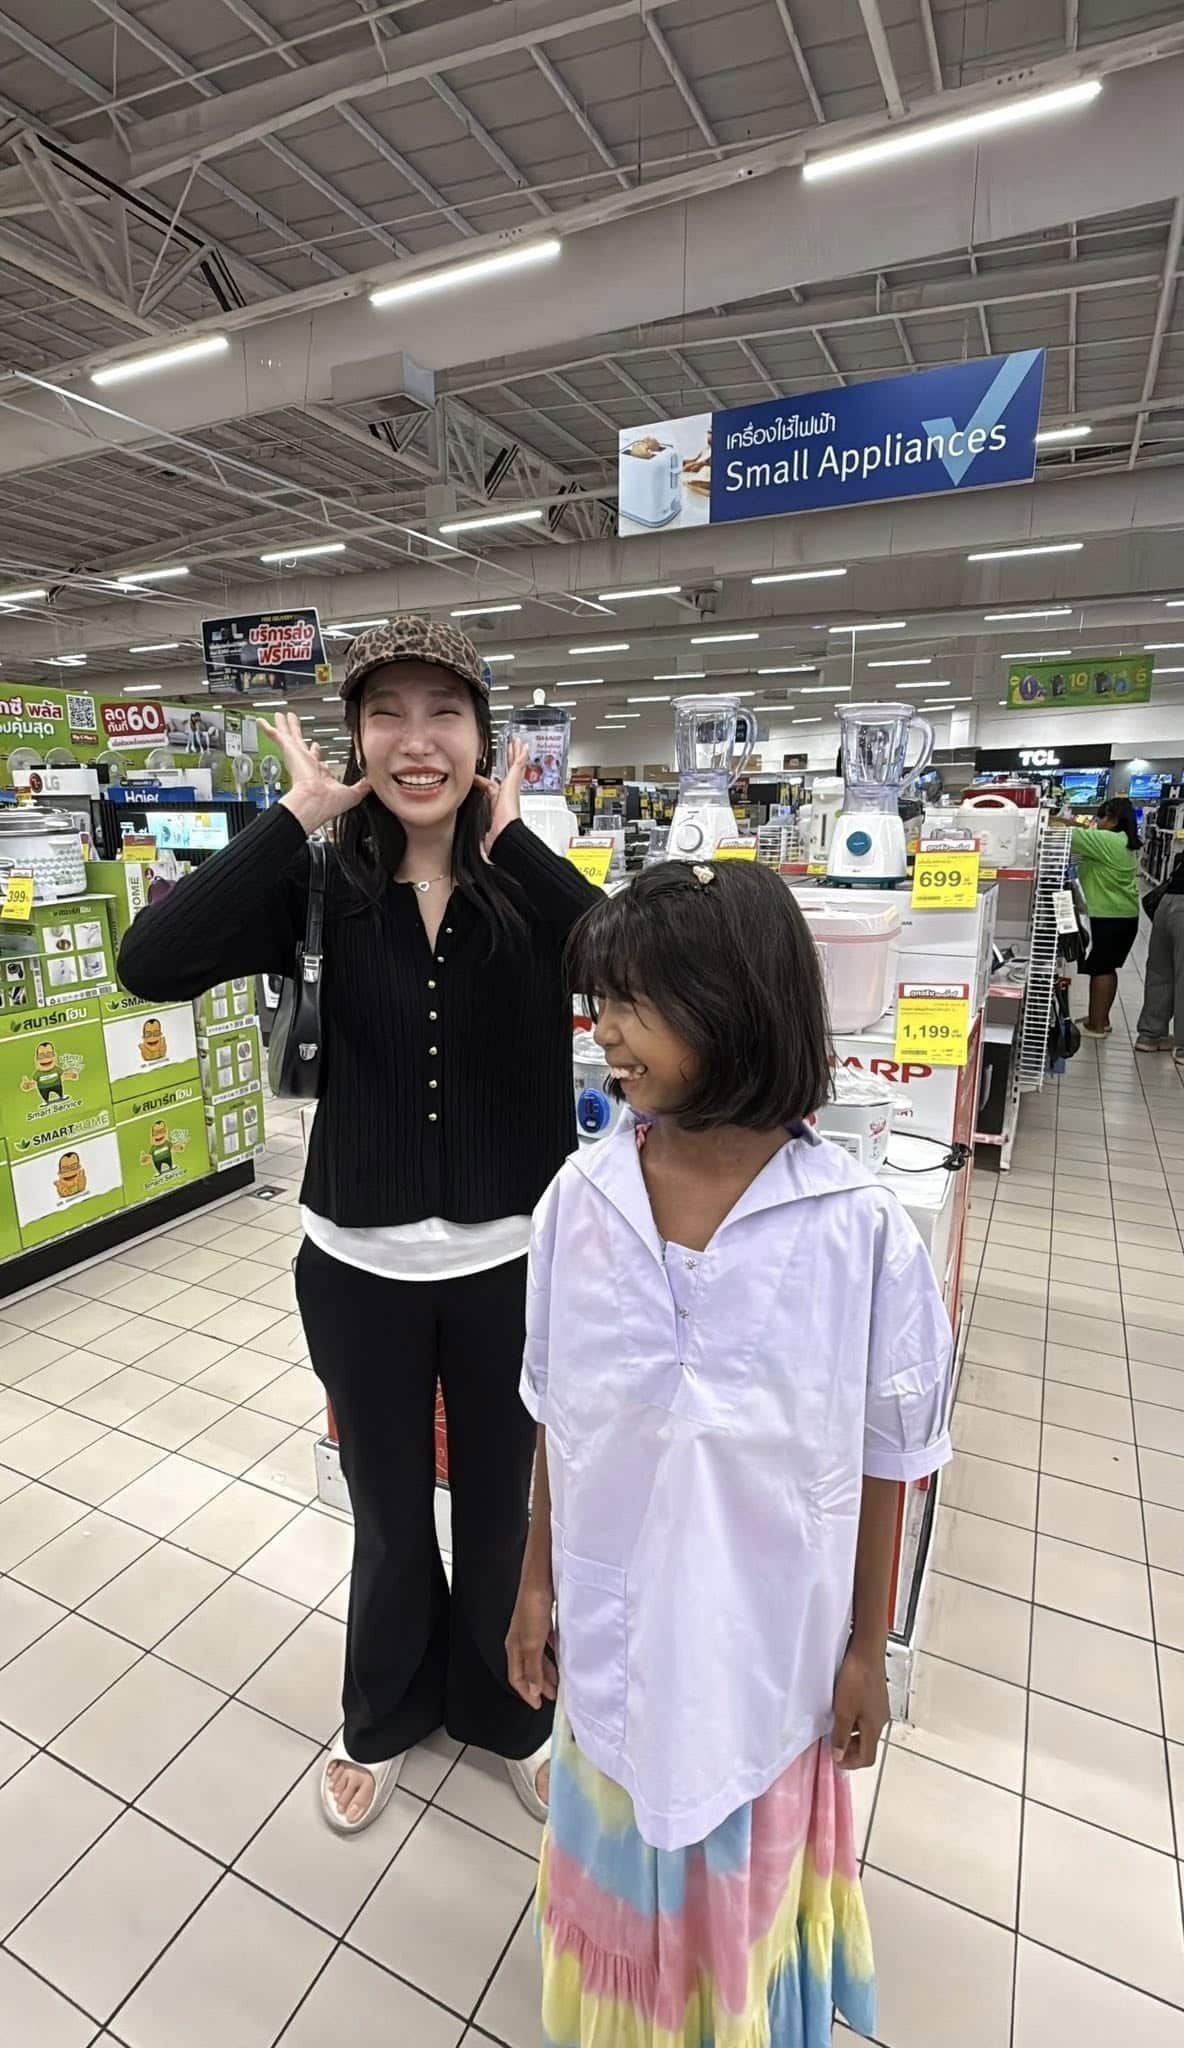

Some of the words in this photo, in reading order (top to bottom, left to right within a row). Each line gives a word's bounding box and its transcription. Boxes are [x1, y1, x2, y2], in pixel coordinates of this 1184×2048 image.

[726, 412, 836, 450] เครื่องใช้ไฟฟ้า
[725, 449, 809, 492] Small
[817, 424, 1007, 482] Appliances
[250, 621, 314, 643] บริการส่ง
[259, 641, 311, 664] ฟรีทันที
[28, 700, 62, 719] พลัส
[105, 708, 125, 721] ลด
[107, 719, 128, 733] ทันที
[1019, 750, 1060, 766] TCL
[43, 778, 59, 791] LG
[920, 870, 961, 887] 699
[8, 891, 26, 903] 399
[23, 1007, 87, 1031] สมาร์ทโฮม
[903, 1024, 950, 1040] 1,199
[143, 1088, 192, 1112] สมาร์ทโฮม
[27, 1107, 51, 1121] Smart
[53, 1100, 82, 1113] Service
